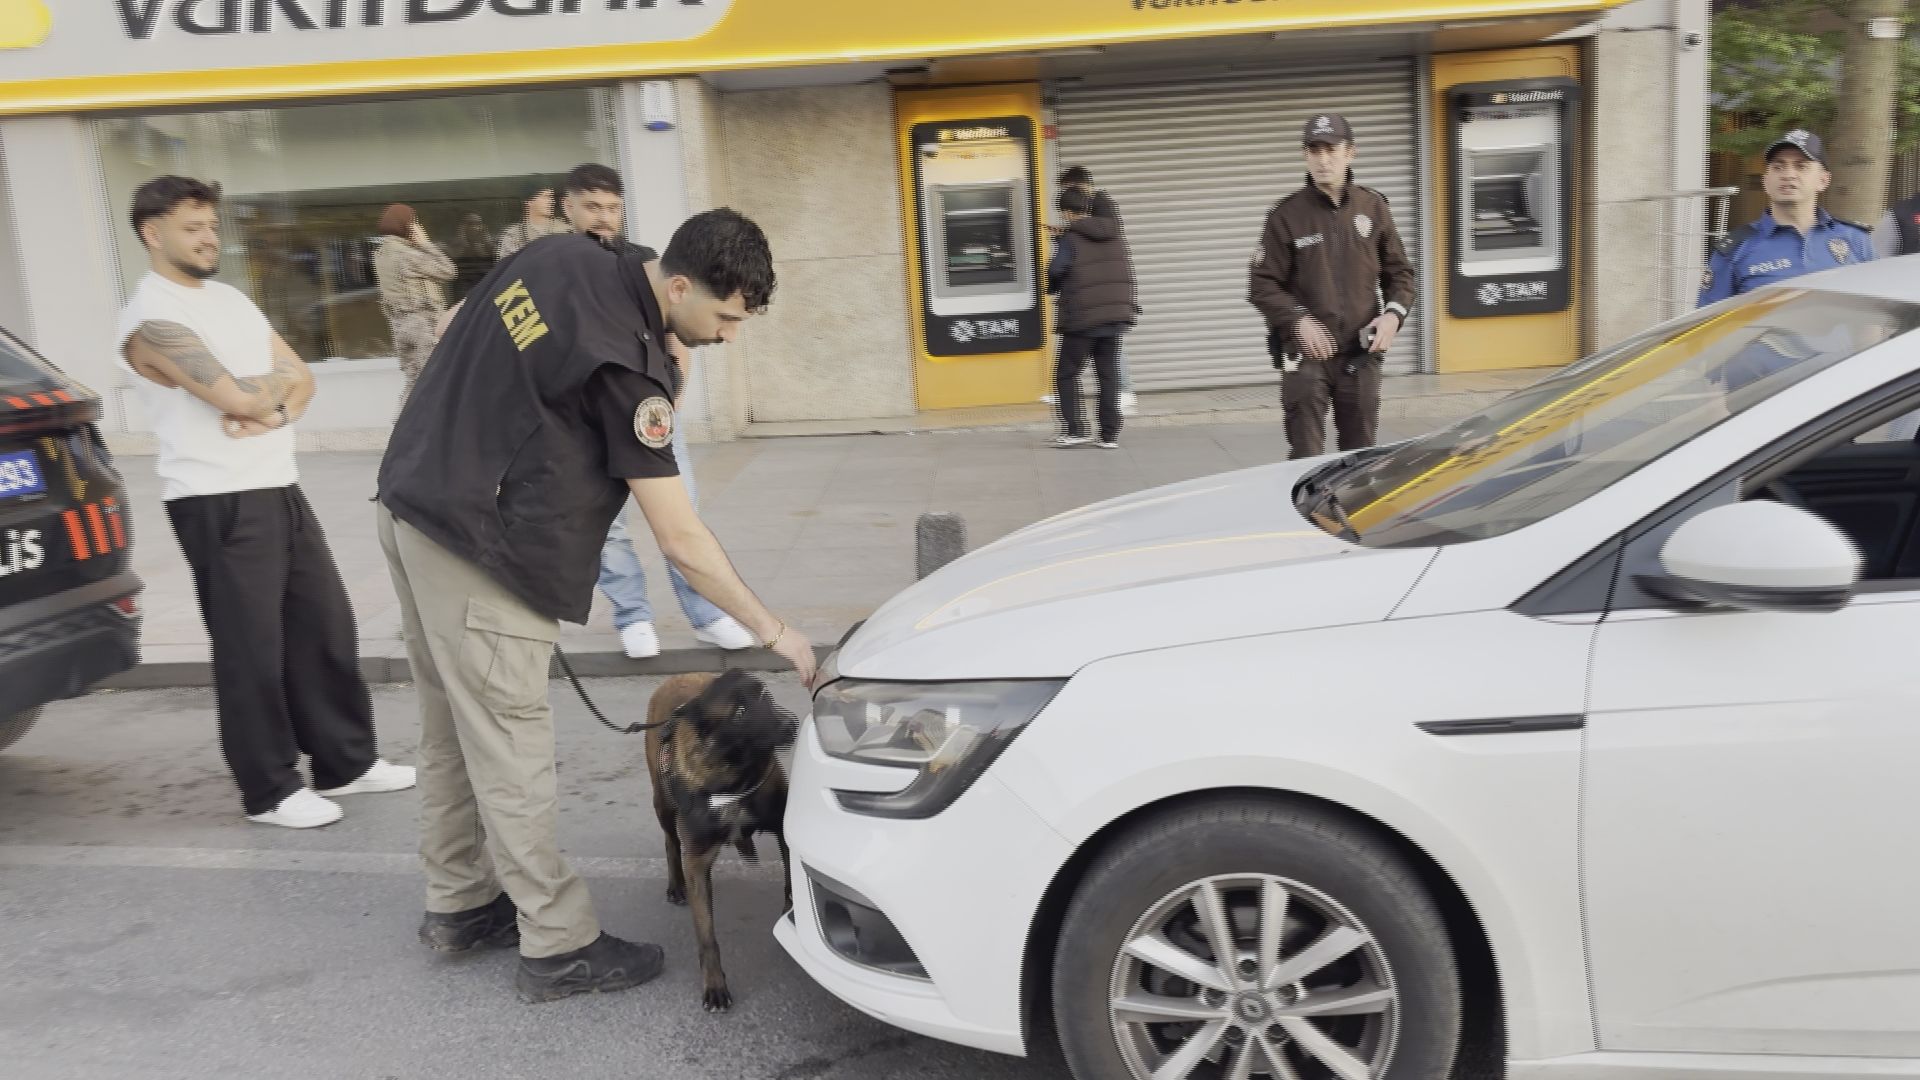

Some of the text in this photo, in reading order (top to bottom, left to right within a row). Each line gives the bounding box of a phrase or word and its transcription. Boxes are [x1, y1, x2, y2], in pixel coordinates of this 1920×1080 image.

[1503, 281, 1548, 298] TAM
[493, 278, 549, 352] KEM
[974, 319, 1020, 336] TAM
